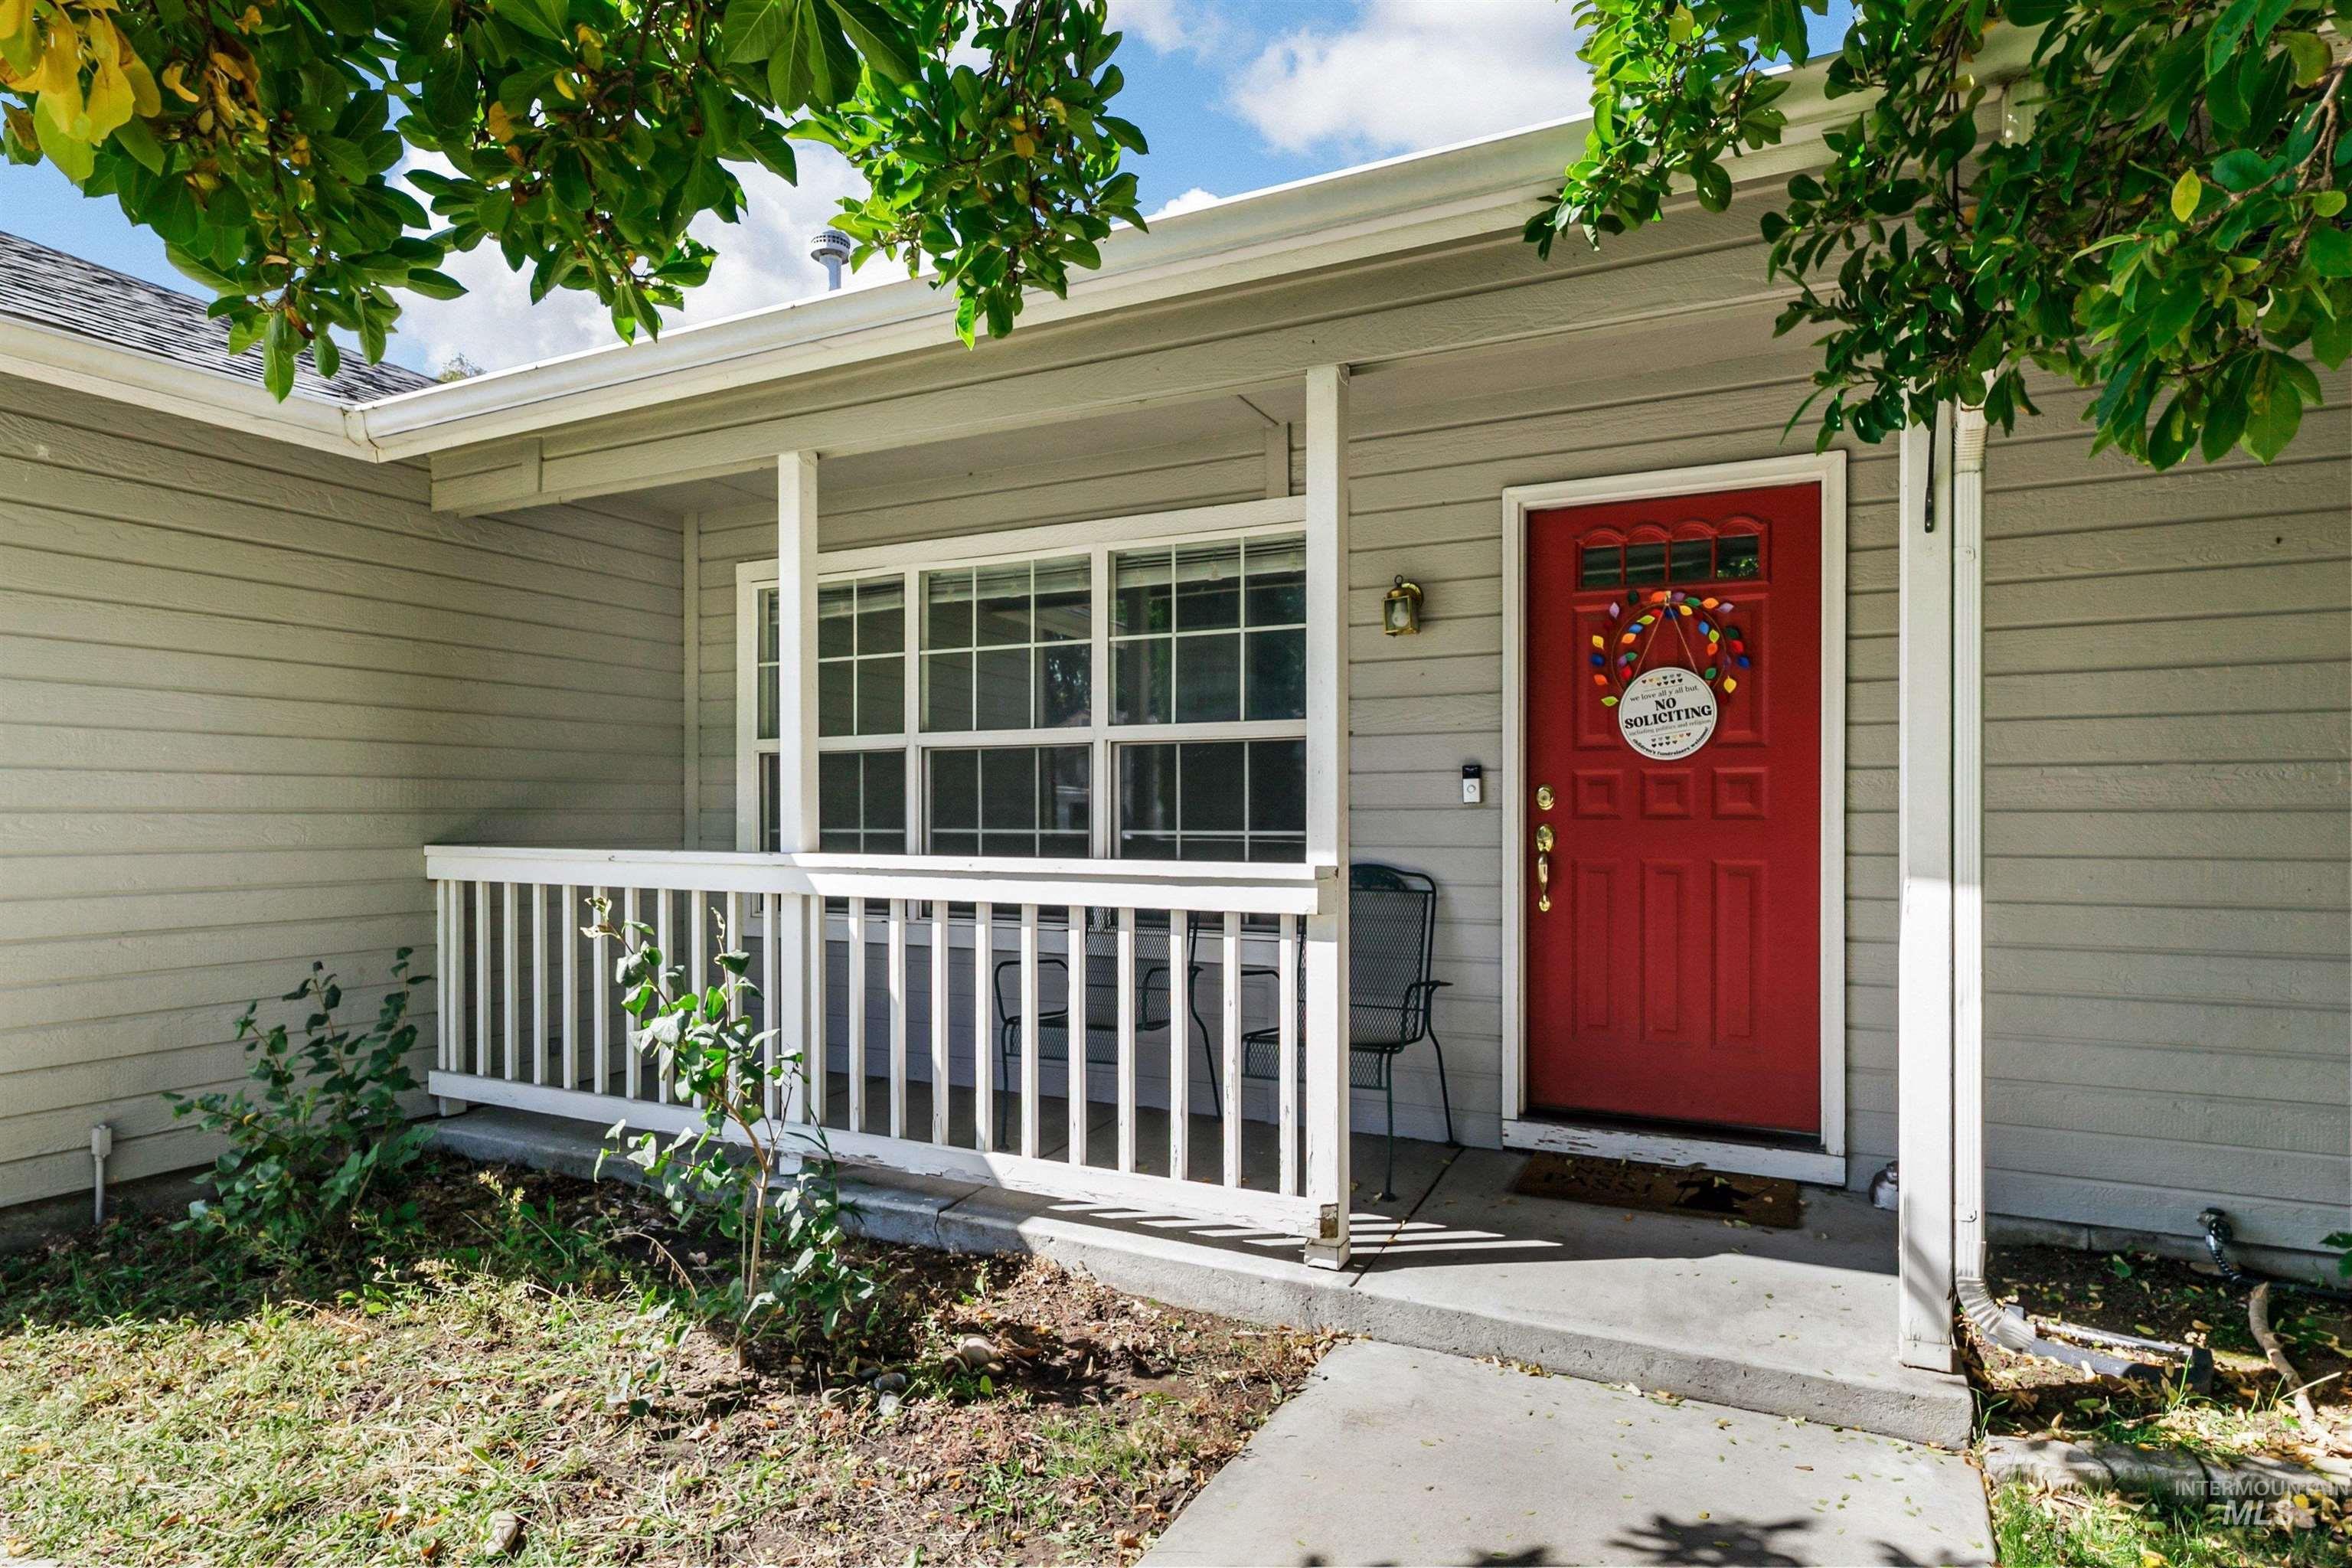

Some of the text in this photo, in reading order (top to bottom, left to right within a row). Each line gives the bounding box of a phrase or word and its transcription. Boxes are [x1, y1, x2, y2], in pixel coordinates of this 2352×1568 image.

[1641, 692, 1656, 701] love
[1655, 697, 1677, 711] NO
[1624, 704, 1713, 730] SOLICITING
